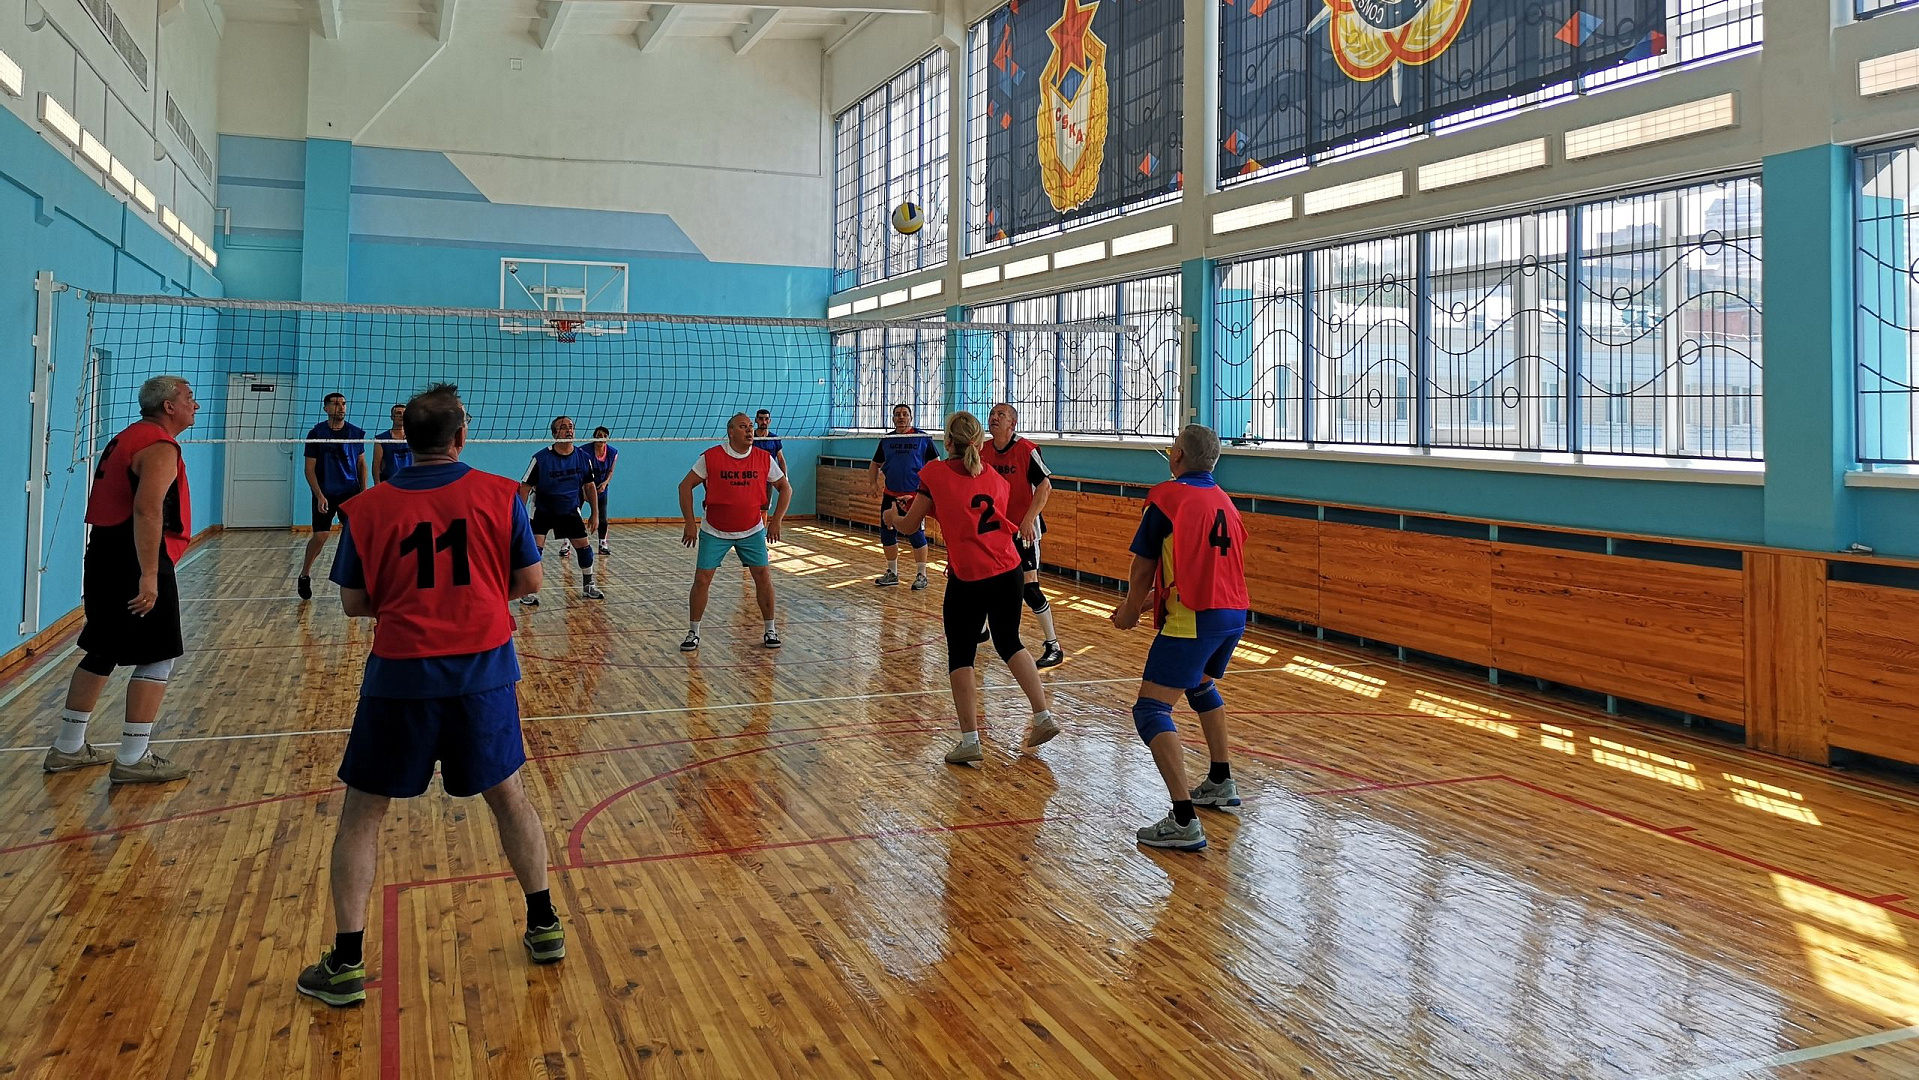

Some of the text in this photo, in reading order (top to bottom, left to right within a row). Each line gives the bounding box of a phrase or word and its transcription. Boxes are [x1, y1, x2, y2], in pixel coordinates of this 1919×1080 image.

[1056, 107, 1084, 144] CSKA
[720, 470, 740, 480] ЦСК
[971, 494, 1001, 535] 2
[1208, 509, 1232, 557] 4
[400, 518, 471, 589] 11
